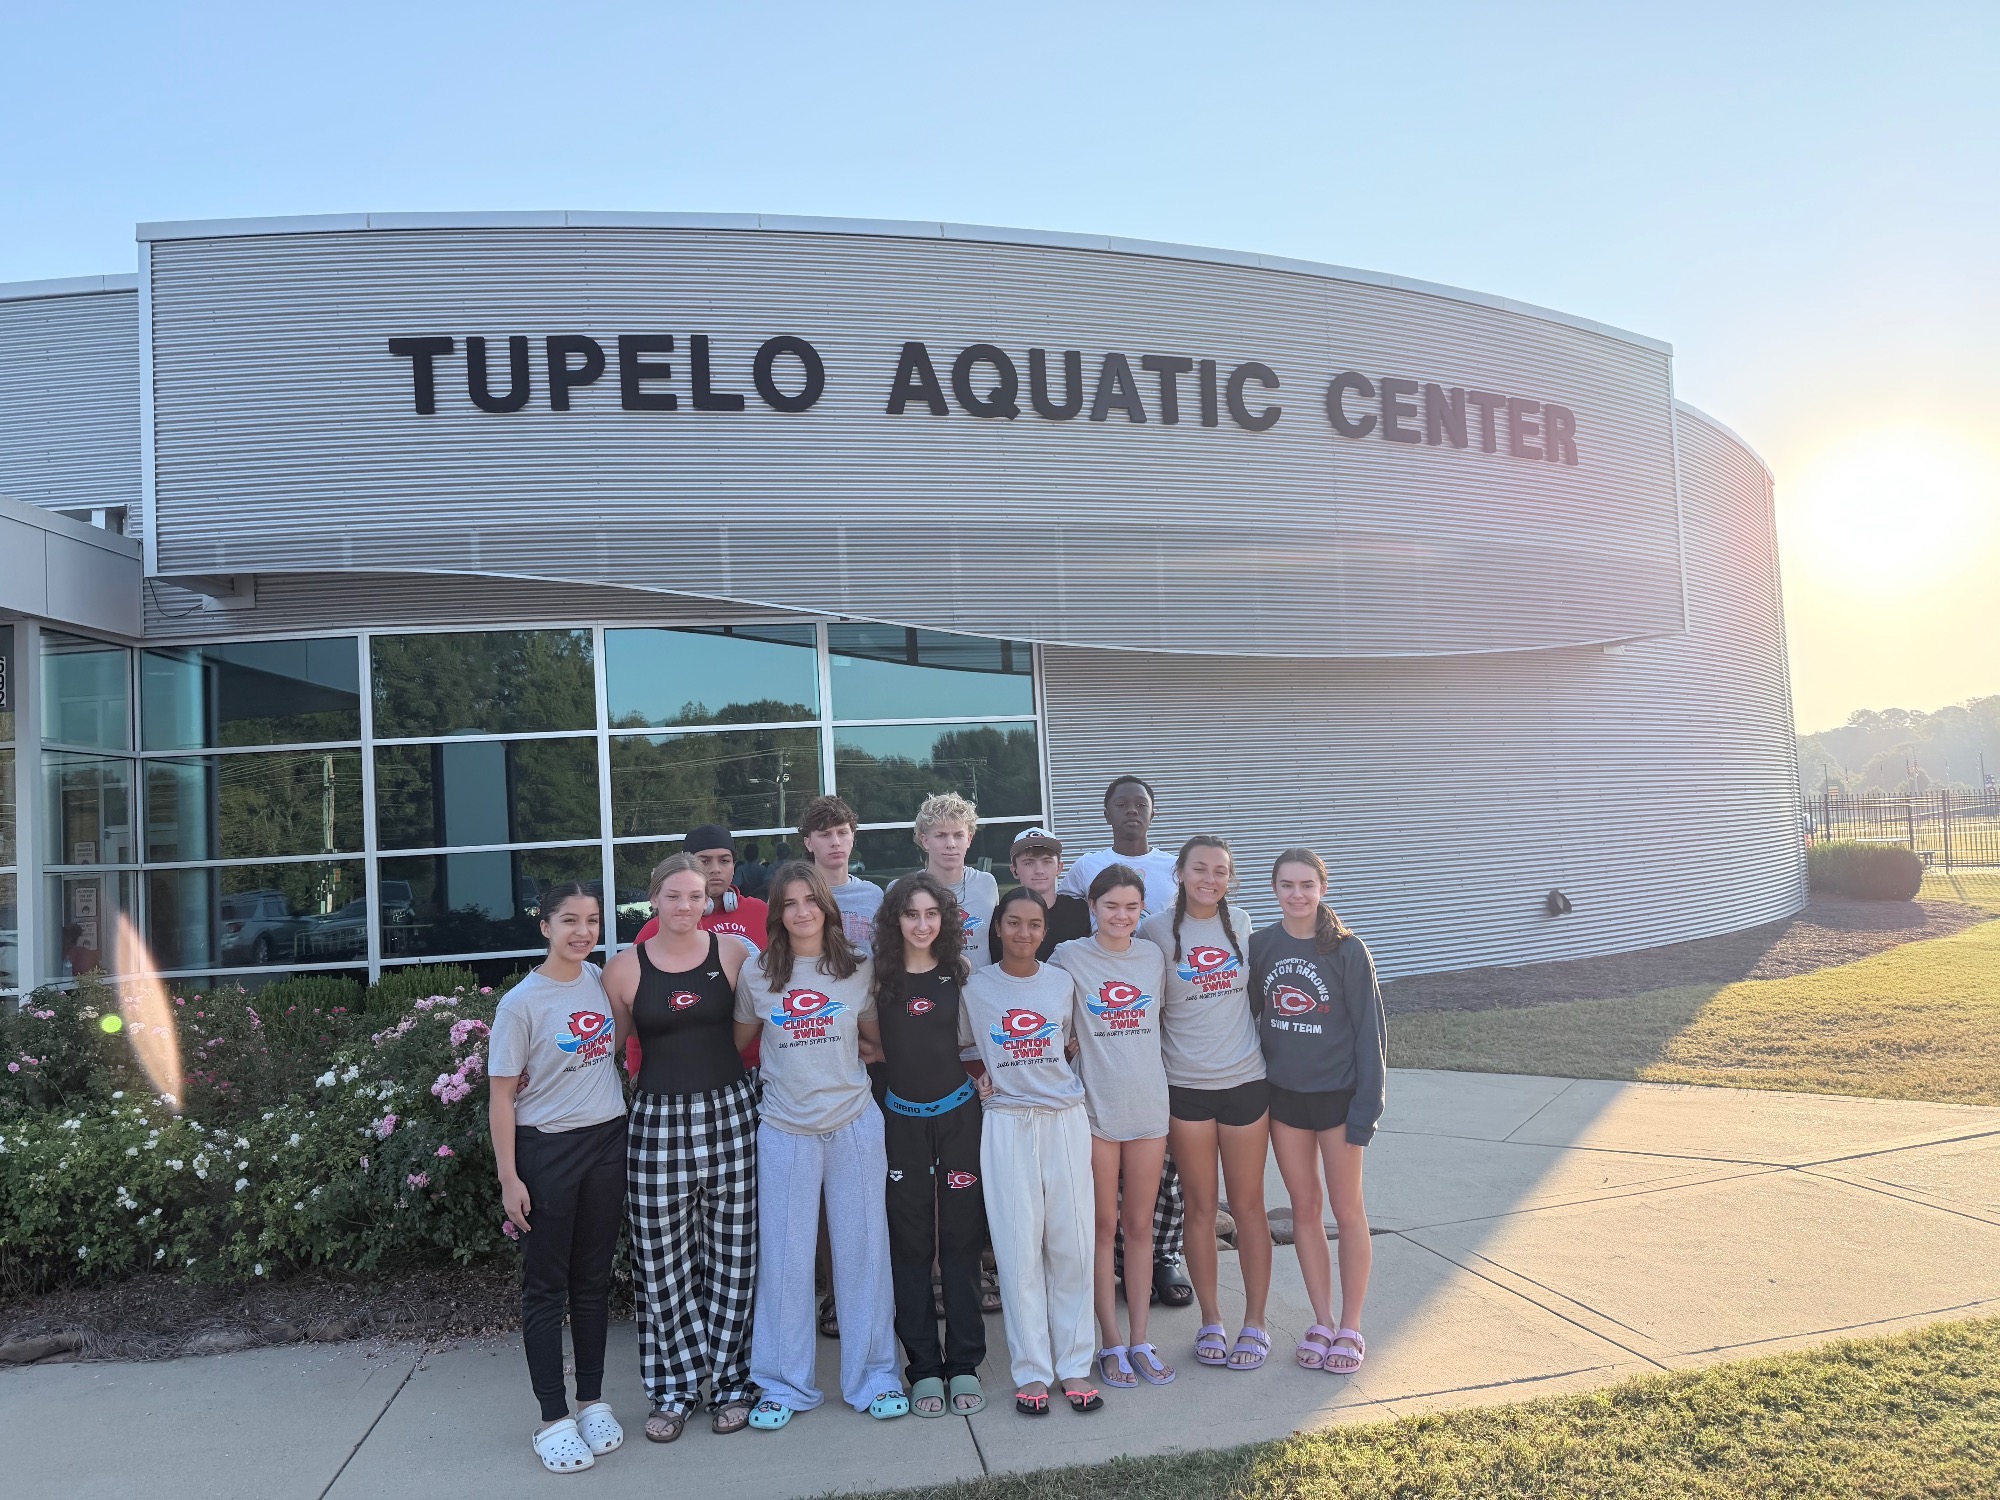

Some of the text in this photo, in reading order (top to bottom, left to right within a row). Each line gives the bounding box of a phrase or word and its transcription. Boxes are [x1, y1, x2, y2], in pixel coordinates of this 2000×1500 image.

[389, 334, 1579, 466] TUPELO AQUATIC CENTER
[708, 922, 746, 933] INTON
[1197, 950, 1223, 966] C
[1275, 957, 1317, 970] PROPERTY OF
[1191, 969, 1238, 985] CLINTON
[1263, 964, 1329, 1002] CLINTON ARROWS
[1202, 980, 1231, 992] SWIM
[676, 994, 694, 1005] C
[1108, 986, 1134, 1002] C
[793, 994, 820, 1011] C
[913, 1001, 929, 1011] C
[1281, 992, 1307, 1012] C
[1100, 1009, 1146, 1020] CLINTON
[578, 1015, 600, 1032] C
[783, 1016, 834, 1030] CLINTON
[1011, 1014, 1039, 1031] C
[1110, 1019, 1139, 1029] SWIM
[1292, 1022, 1323, 1034] TEAM
[793, 1027, 826, 1040] SWIM
[1003, 1037, 1051, 1051] CLINTON
[1012, 1048, 1043, 1059] SWIM
[893, 1102, 920, 1113] arena
[954, 1174, 971, 1185] C
